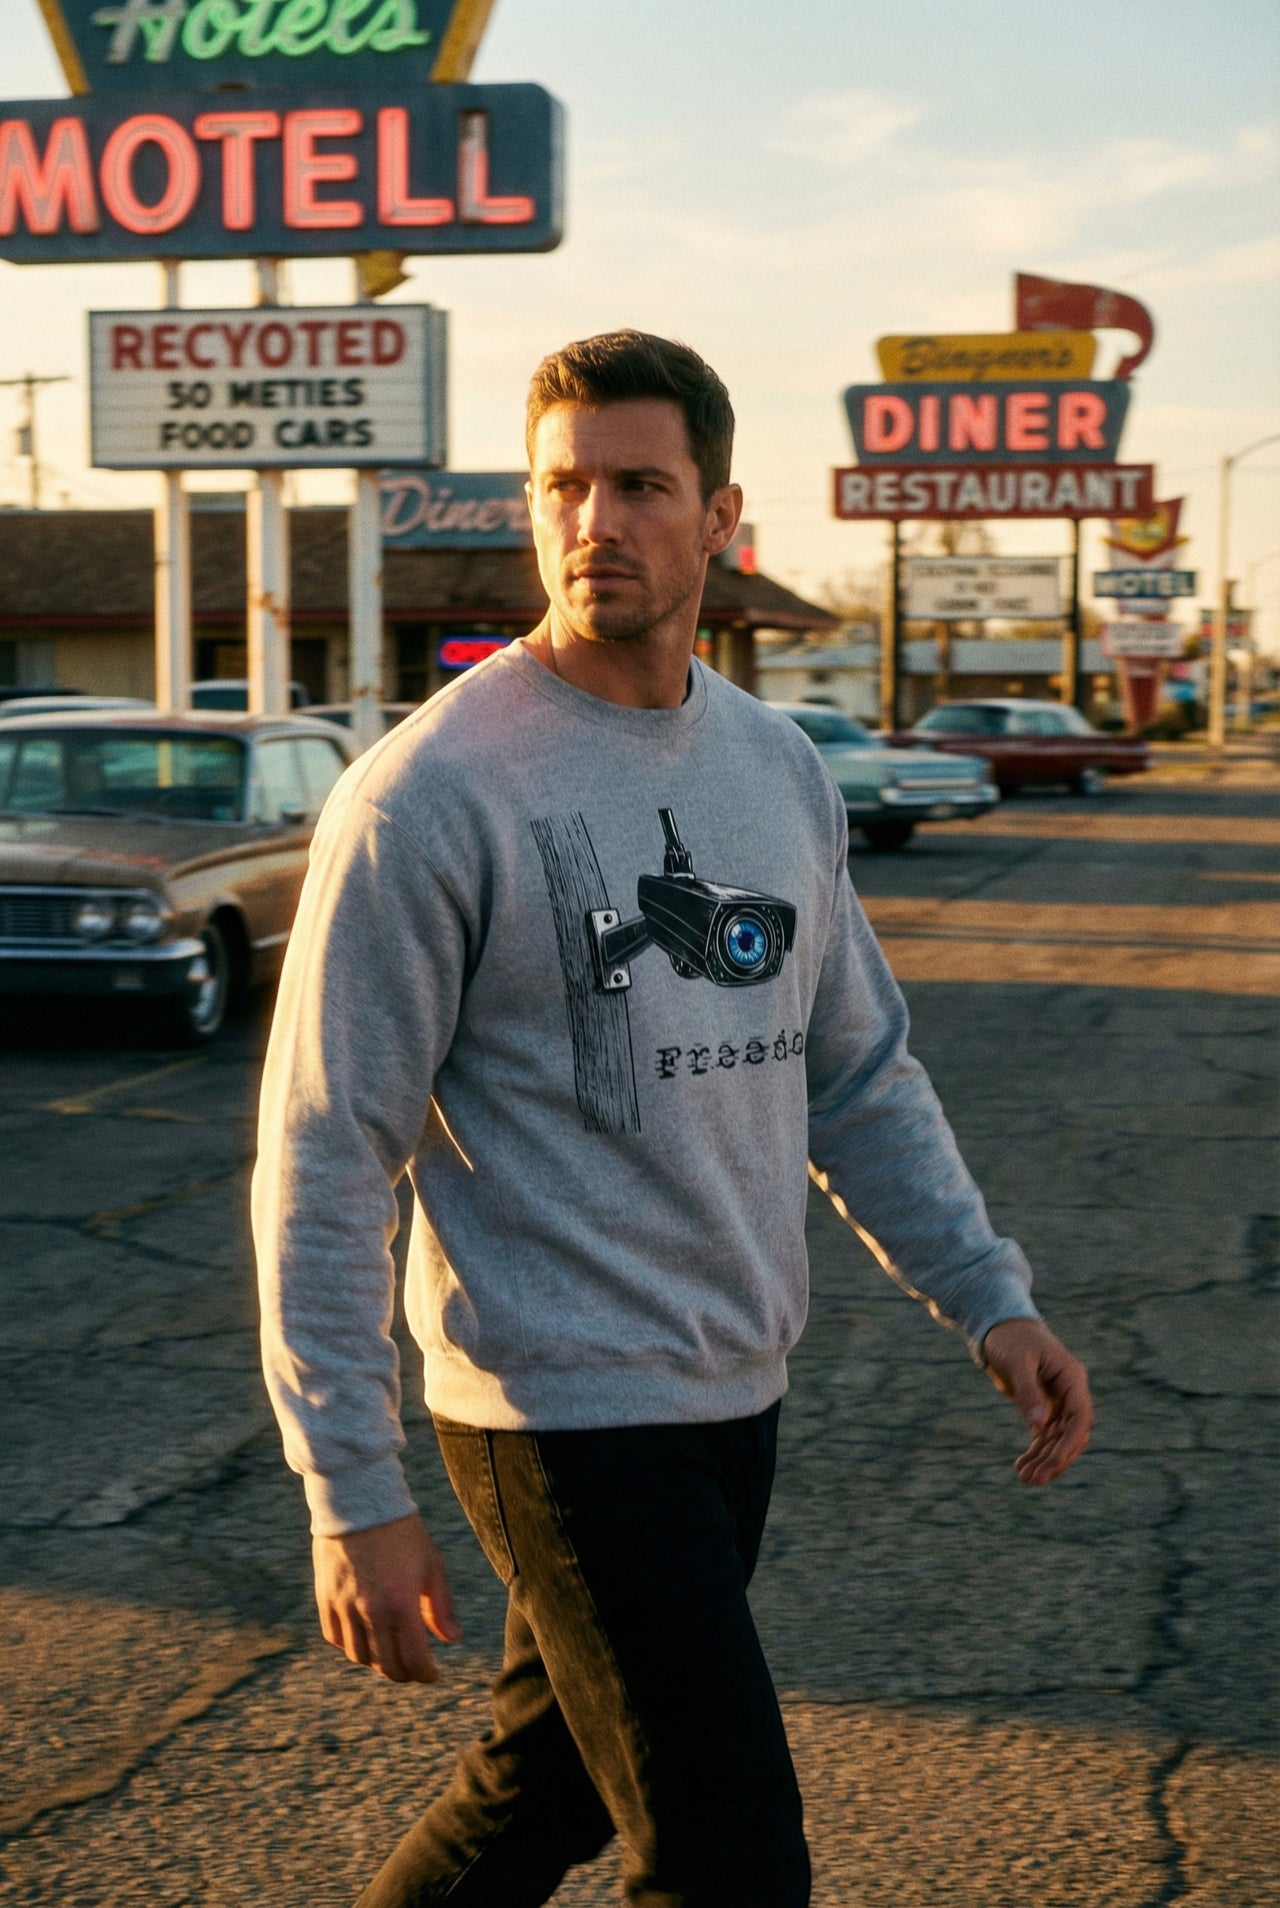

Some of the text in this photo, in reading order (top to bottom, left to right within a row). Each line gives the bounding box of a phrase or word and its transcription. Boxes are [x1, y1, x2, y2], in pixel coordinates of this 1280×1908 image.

[0, 108, 536, 235] MOTELL
[111, 320, 406, 370] RECYOTED
[160, 418, 373, 449] FOOD CARS
[864, 393, 1107, 452] DINER
[843, 471, 1145, 512] RESTAURANT
